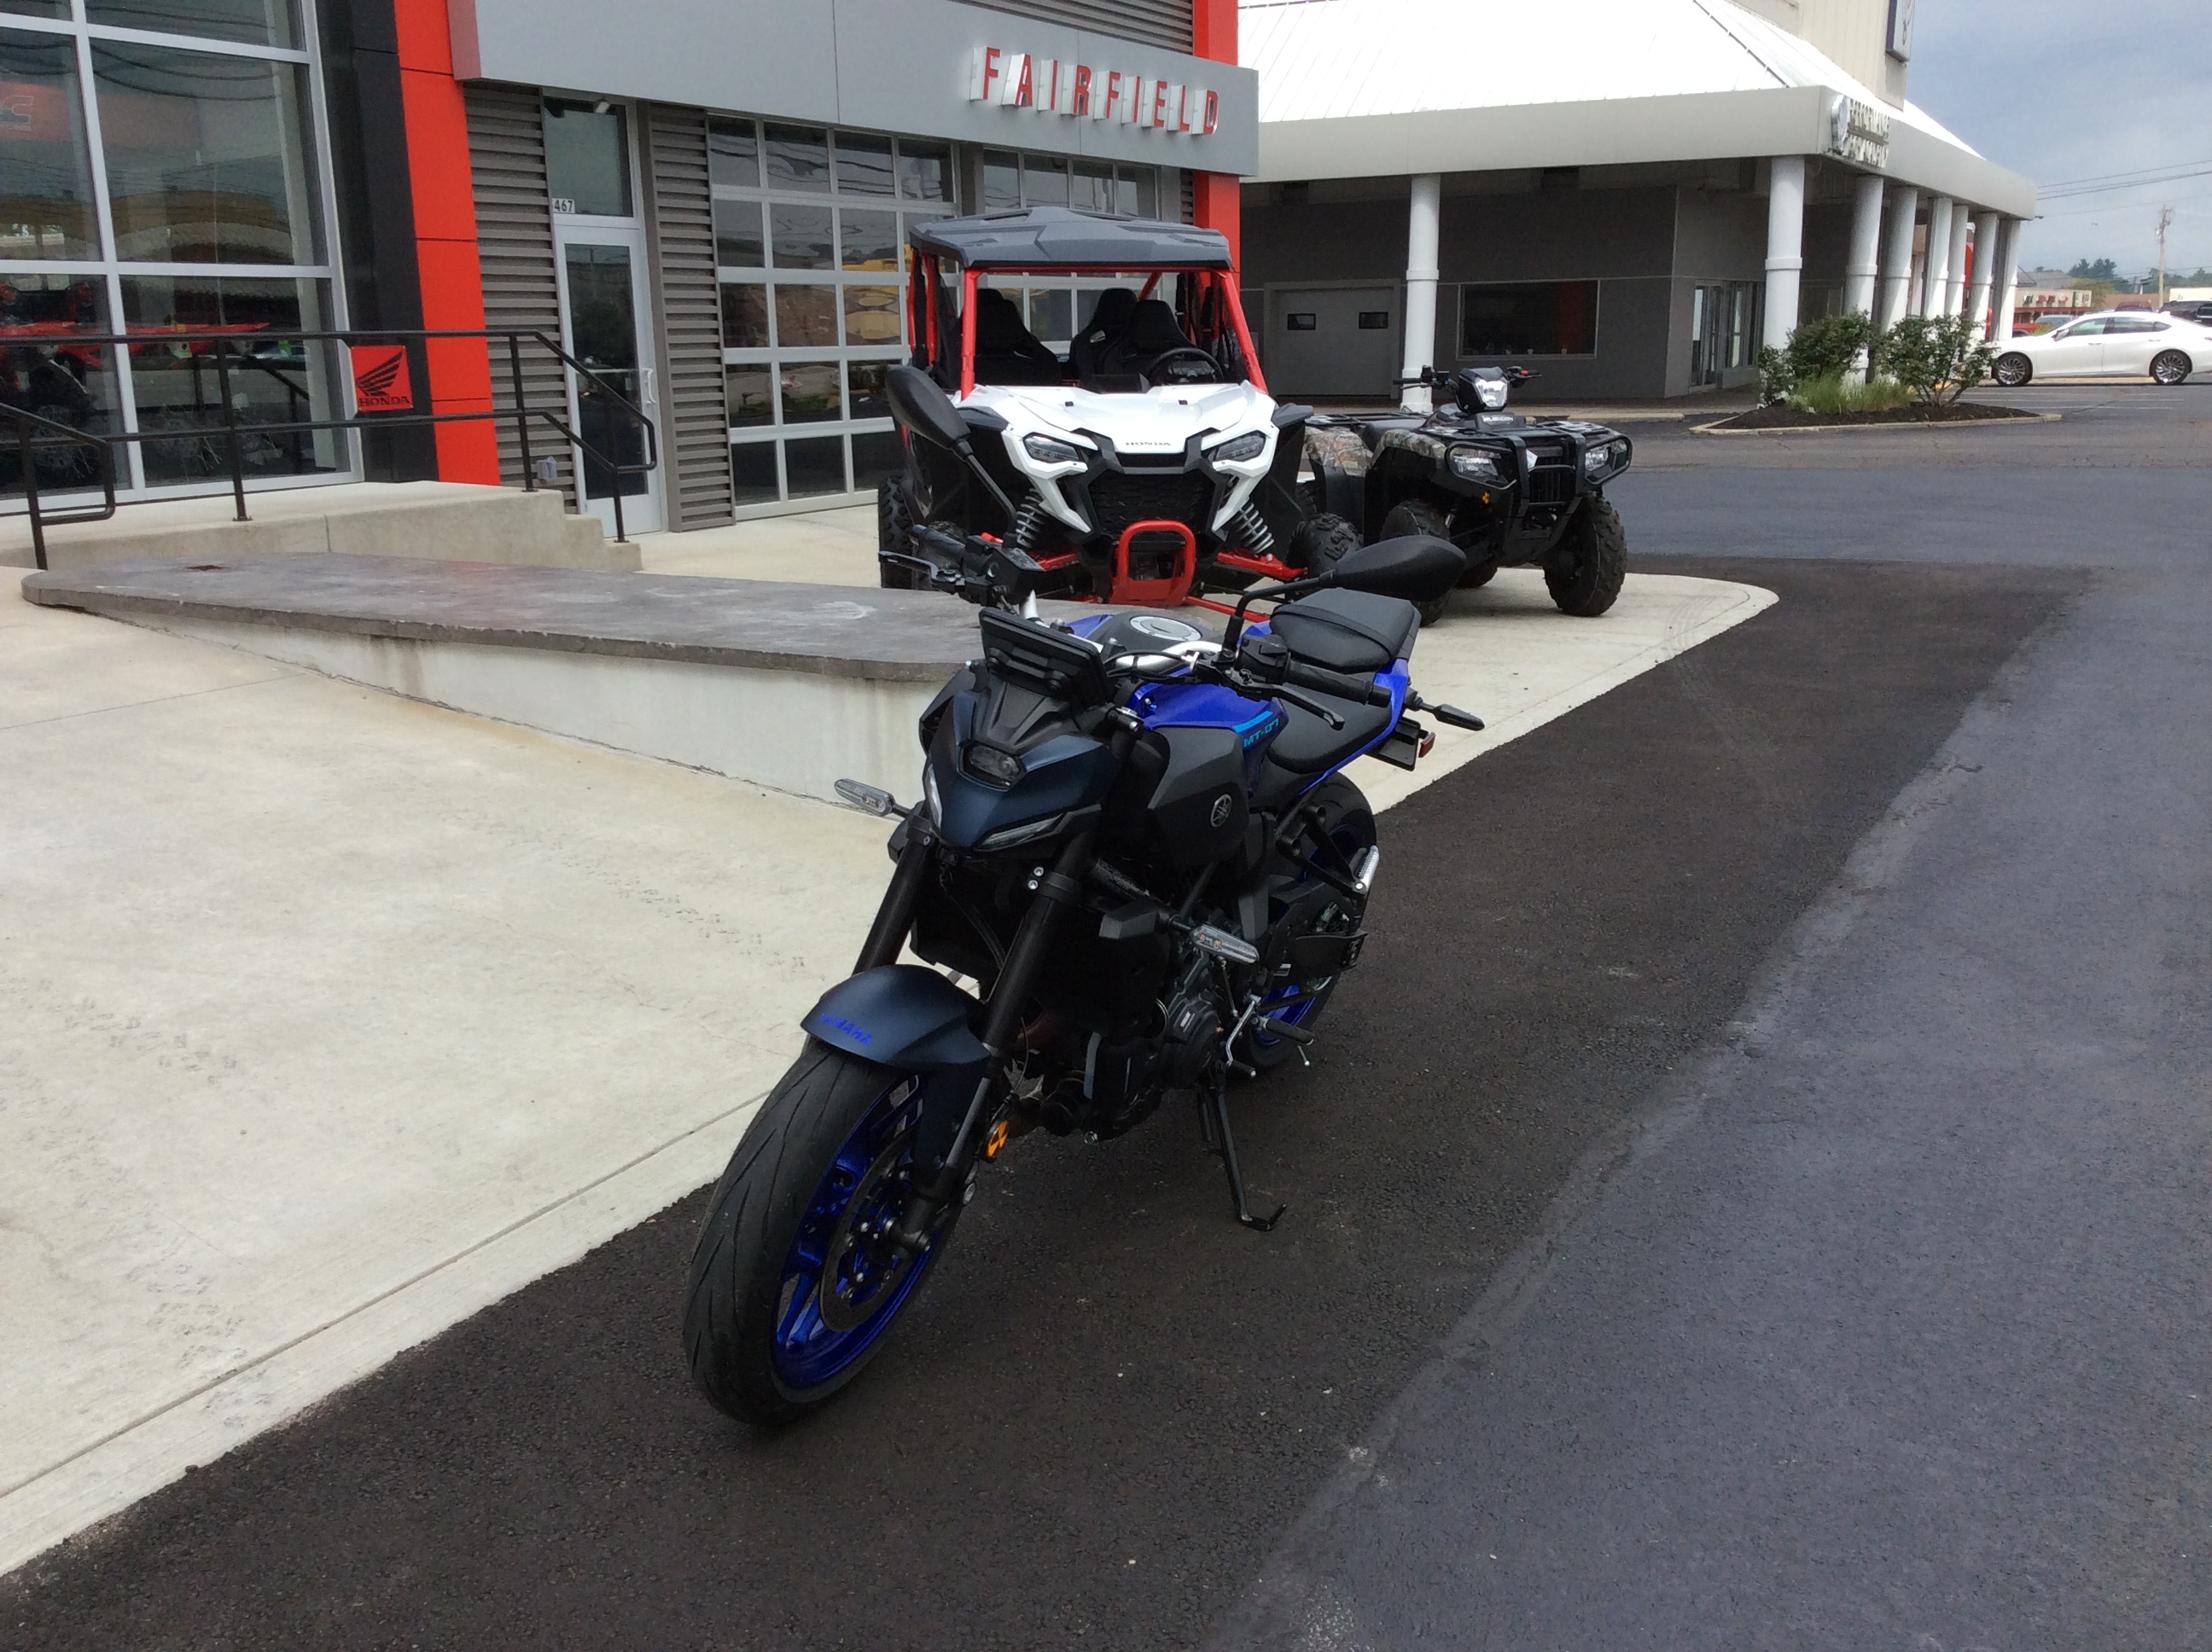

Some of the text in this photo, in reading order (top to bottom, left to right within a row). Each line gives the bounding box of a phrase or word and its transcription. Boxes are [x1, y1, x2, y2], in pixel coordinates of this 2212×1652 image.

[975, 46, 1219, 135] FAIRFIELD
[554, 199, 573, 212] 467
[358, 396, 411, 407] HONDA
[1243, 718, 1279, 747] MT-07
